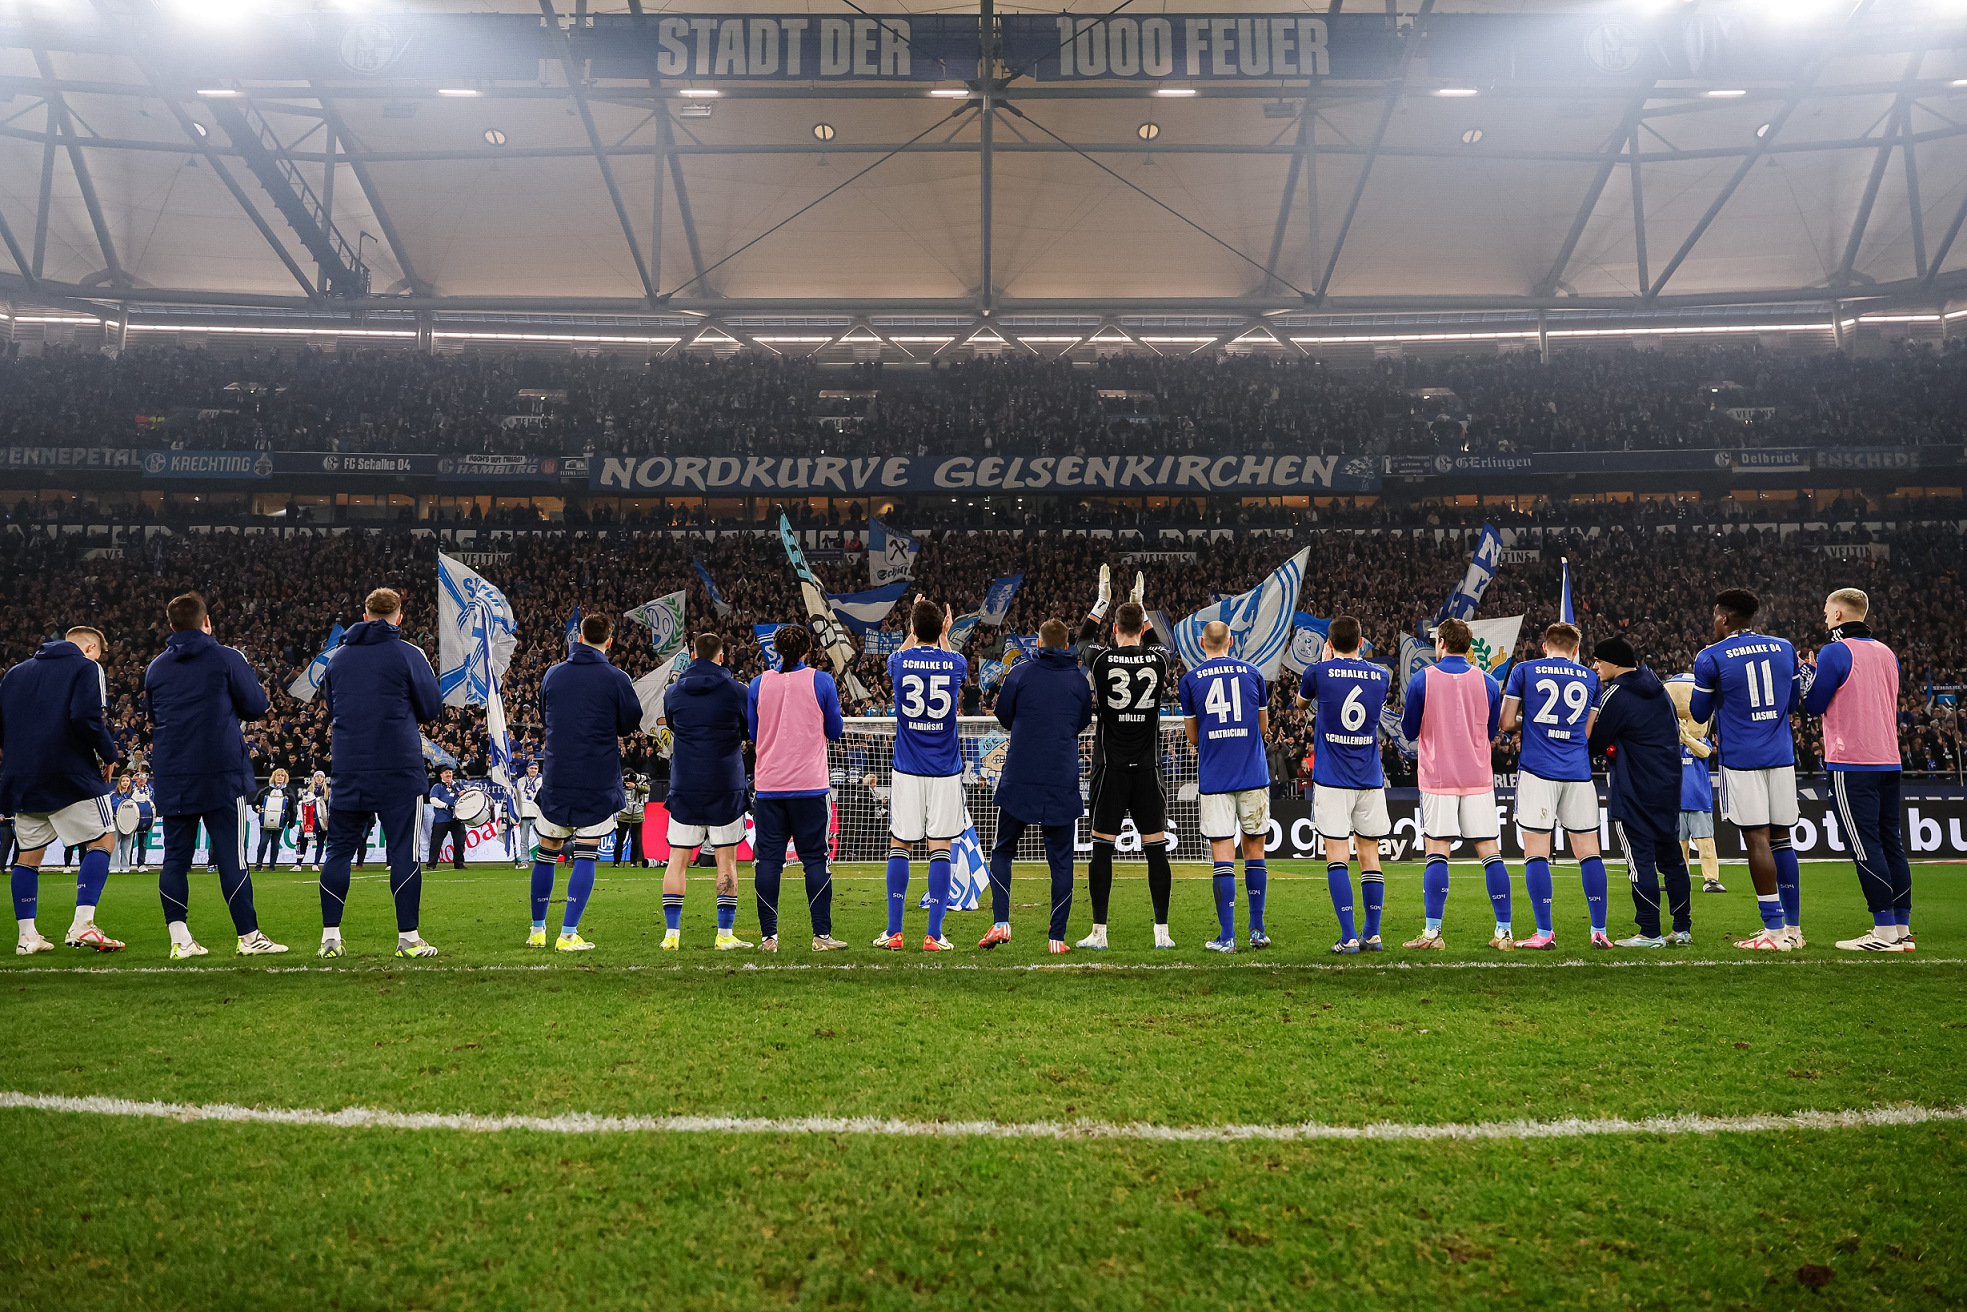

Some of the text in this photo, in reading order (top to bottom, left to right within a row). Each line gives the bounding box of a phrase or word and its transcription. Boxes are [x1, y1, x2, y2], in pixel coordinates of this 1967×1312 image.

[657, 17, 912, 77] STADT DER
[1056, 16, 1330, 77] 1000 FEUER
[8, 447, 142, 467] ENNEPETAL
[1741, 451, 1799, 464] Delbrück
[1817, 451, 1920, 469] ENSCHEDE
[344, 458, 412, 471] FC Schalke 04
[456, 464, 539, 475] HAMBURG
[599, 456, 1339, 491] NORDKURVE GELSENKIRCHEN
[1503, 551, 1531, 563] TINS
[1725, 643, 1782, 659] SCHALKE 04
[902, 659, 954, 670] SCHALKE 04
[1107, 655, 1157, 664] SCHALKE 04
[1196, 666, 1248, 679] SCHALKE 04
[1328, 668, 1382, 681] SCHALKE 04
[1535, 666, 1588, 679] SCHALKE 04
[1107, 667, 1158, 710] 32
[1745, 659, 1775, 708] 11
[901, 674, 952, 720] 35
[1204, 676, 1242, 724] 41
[1532, 678, 1589, 726] 29
[1340, 684, 1367, 732] 6
[1118, 713, 1146, 722] MÜLLER
[1751, 710, 1779, 722] LASME
[908, 721, 944, 731] KAMIŃSKI
[1208, 728, 1249, 740] MATRICIANI
[1325, 733, 1374, 745] SCHALLENBERG
[1547, 729, 1571, 740] MOHR
[600, 835, 615, 850] 04
